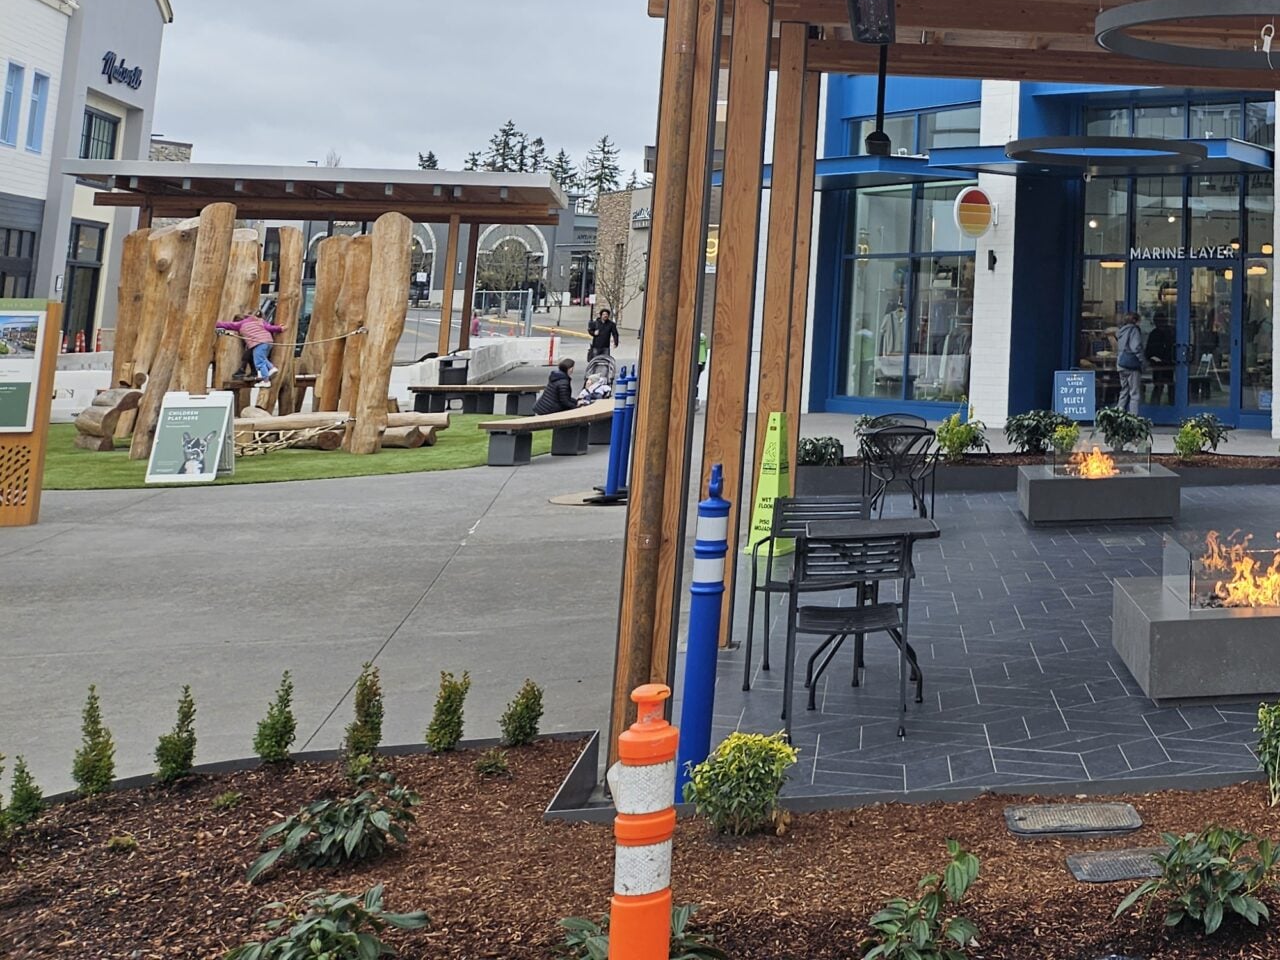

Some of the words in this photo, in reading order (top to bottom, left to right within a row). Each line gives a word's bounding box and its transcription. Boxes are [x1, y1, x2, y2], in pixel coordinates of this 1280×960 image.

[1130, 246, 1185, 260] MARINE
[1189, 246, 1234, 259] LAYER
[1063, 396, 1084, 404] SELECT
